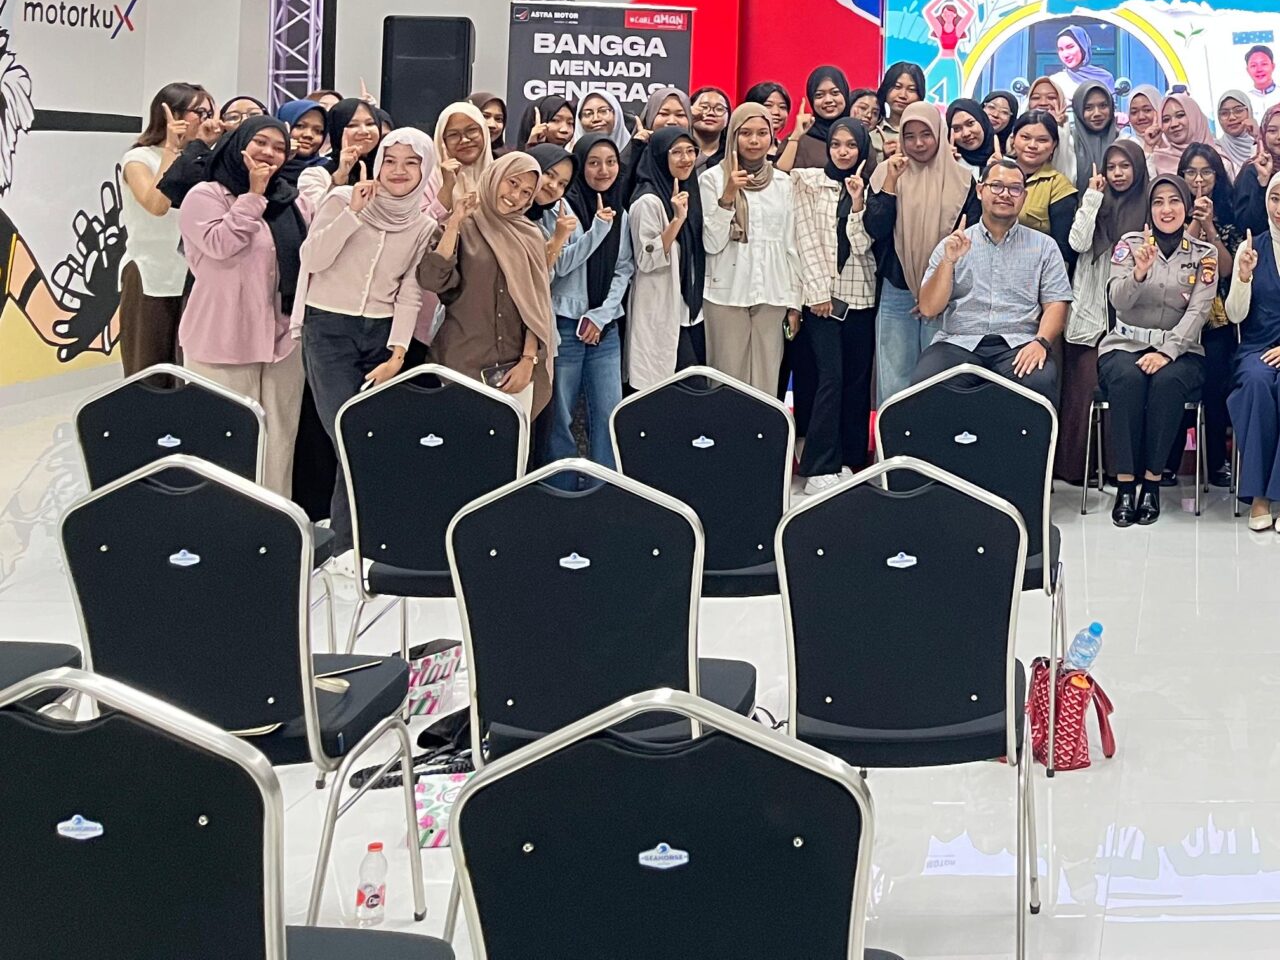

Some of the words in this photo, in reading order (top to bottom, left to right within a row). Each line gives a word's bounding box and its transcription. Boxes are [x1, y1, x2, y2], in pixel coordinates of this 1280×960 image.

[533, 32, 668, 58] BANGGA
[550, 59, 651, 78] MENJADI
[523, 79, 675, 103] GENERA
